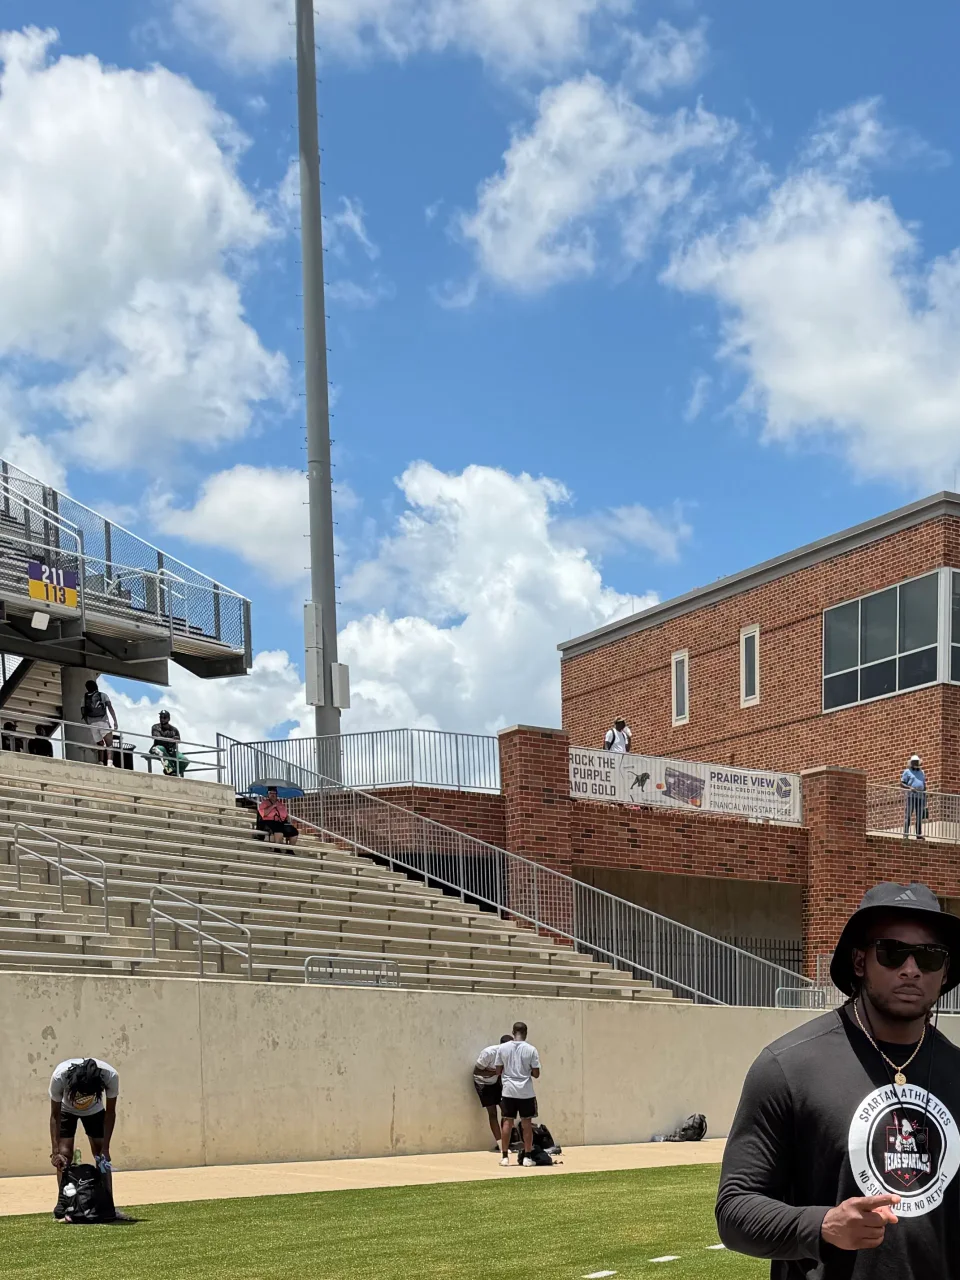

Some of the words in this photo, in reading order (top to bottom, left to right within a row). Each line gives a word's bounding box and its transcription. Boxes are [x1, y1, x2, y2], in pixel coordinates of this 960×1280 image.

[42, 565, 64, 587] 211
[44, 583, 66, 604] 113
[569, 753, 594, 767] ROCK
[597, 756, 615, 770] THE
[573, 767, 611, 782] PURPLE
[710, 771, 748, 786] PRAIRIE
[750, 776, 775, 789] VIEW
[591, 783, 616, 797] GOLD
[710, 783, 734, 792] FEDERAL
[710, 800, 741, 811] FINANCIAL
[742, 804, 758, 813] WINS
[759, 805, 776, 815] START
[859, 1088, 898, 1123] SPARTAN
[901, 1088, 951, 1127] ATHLETICS
[858, 1169, 870, 1184] NO
[914, 1200, 925, 1211] NO
